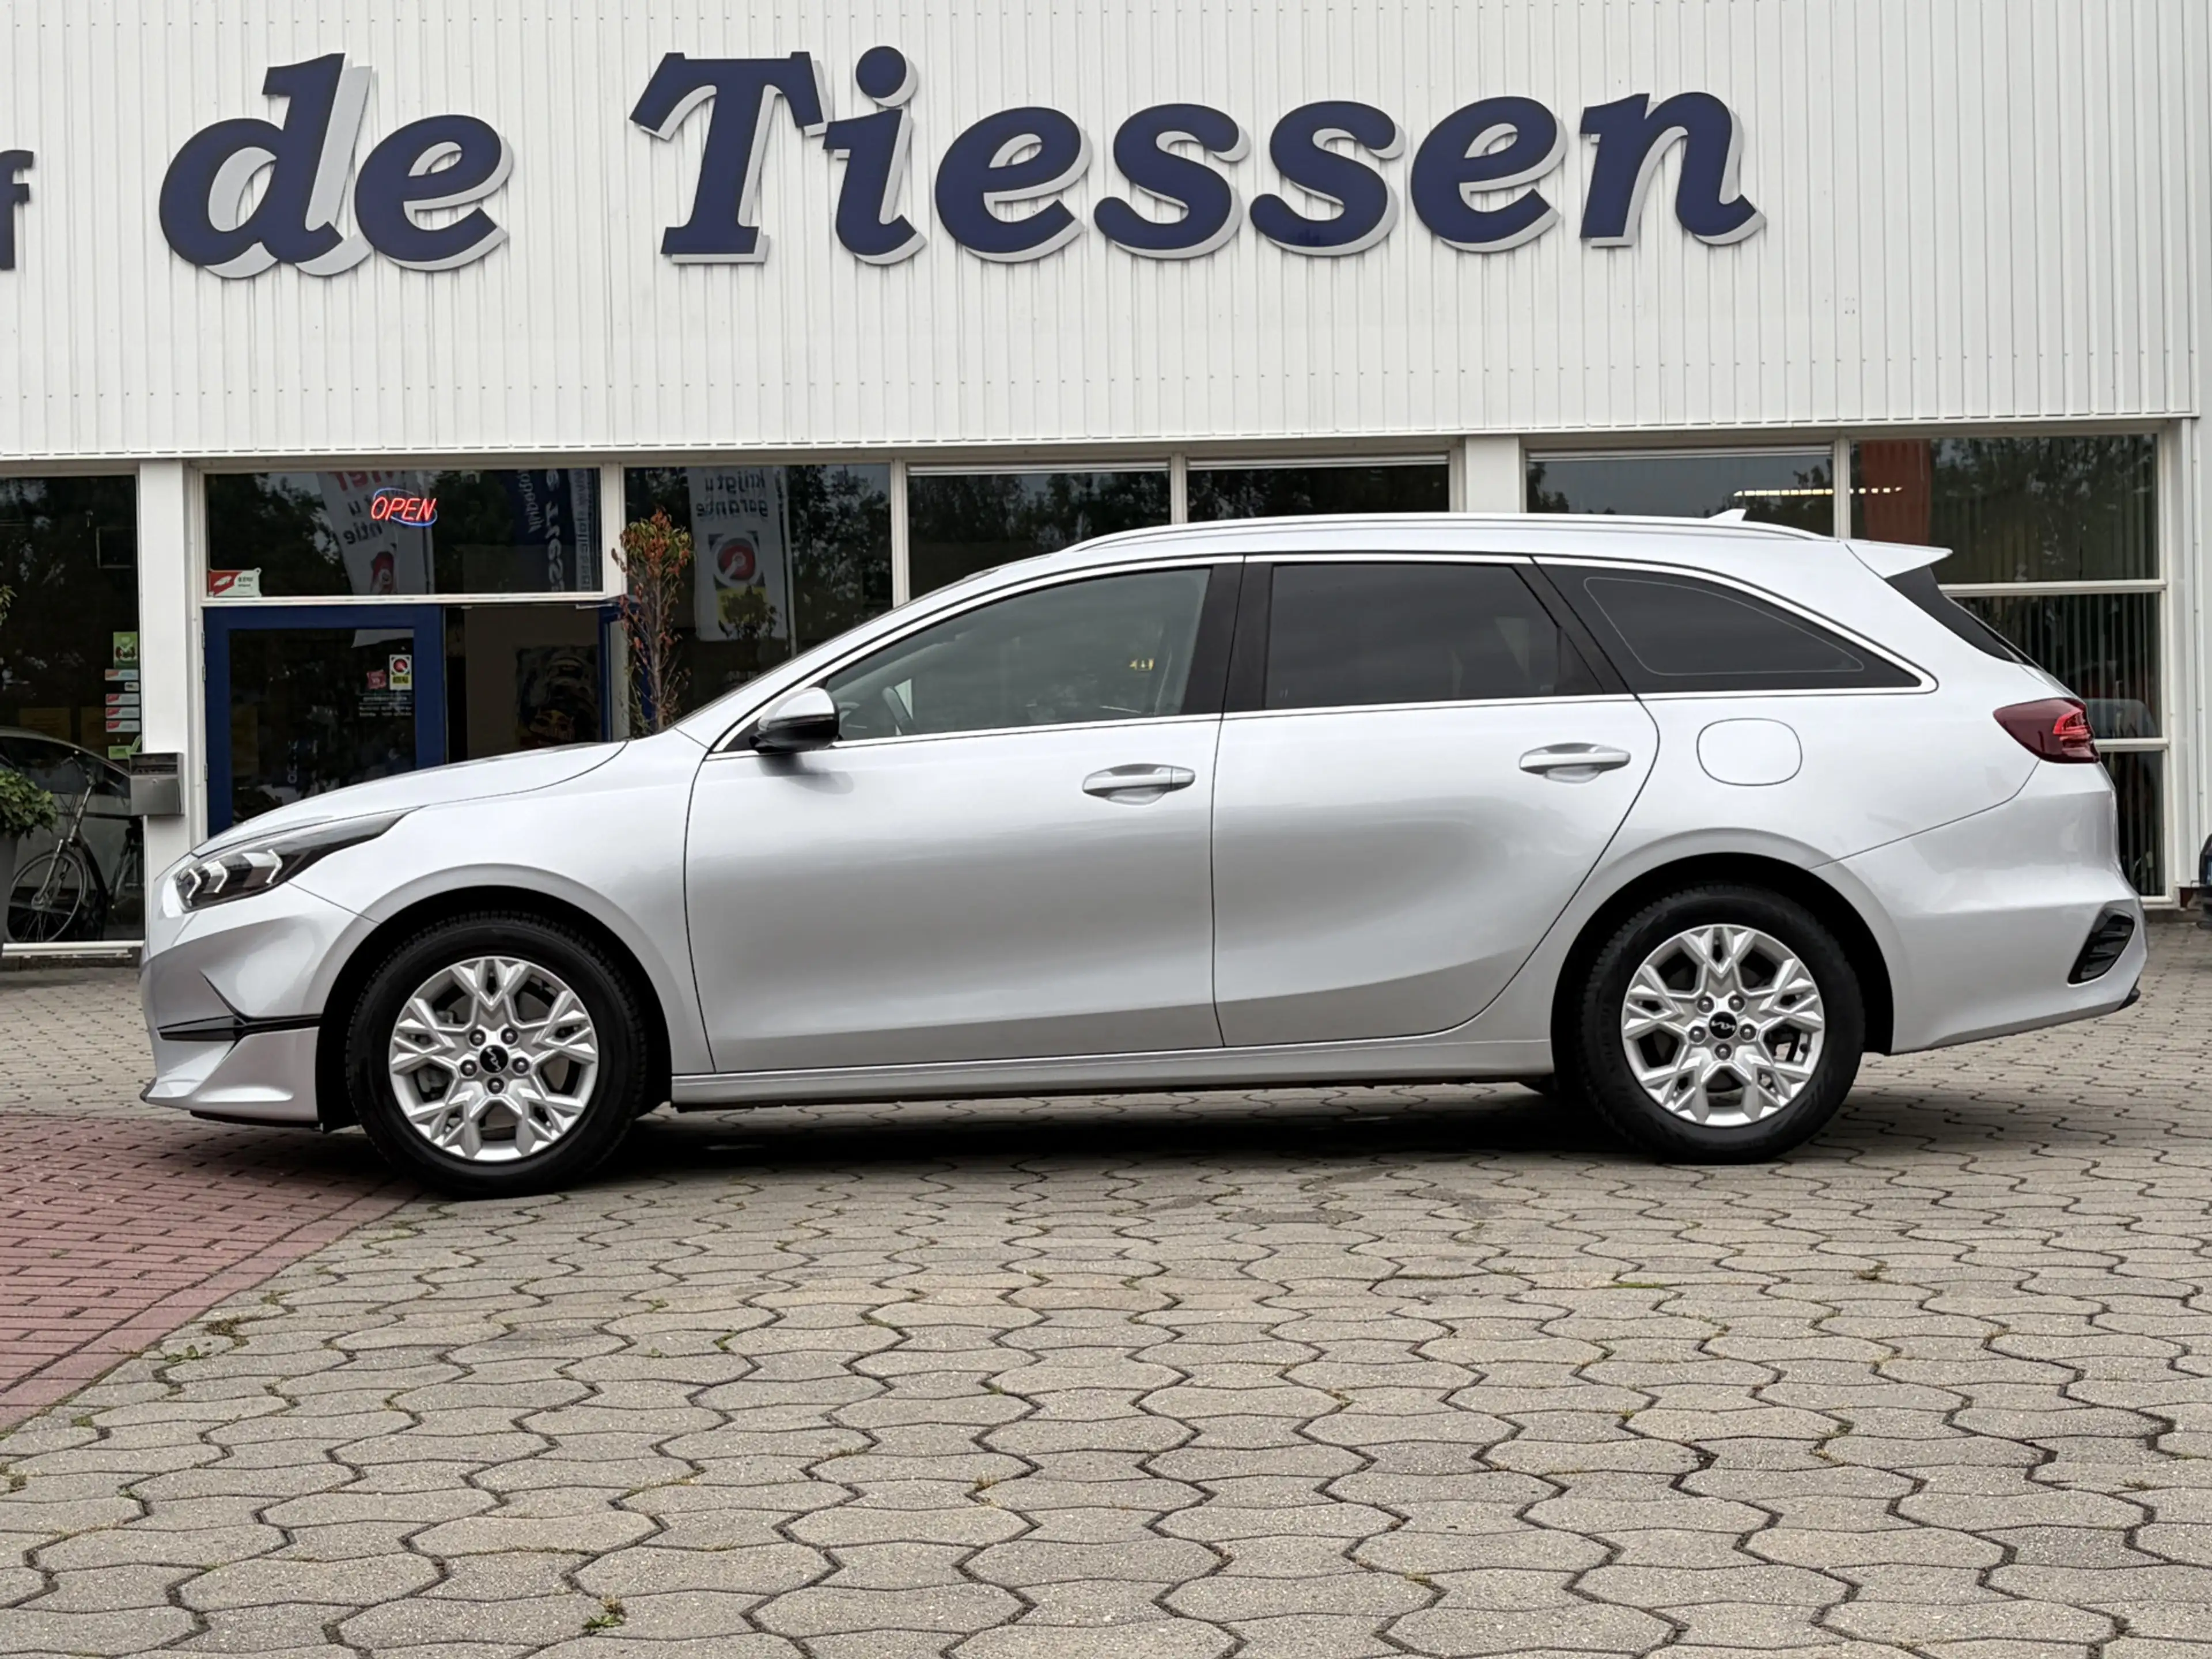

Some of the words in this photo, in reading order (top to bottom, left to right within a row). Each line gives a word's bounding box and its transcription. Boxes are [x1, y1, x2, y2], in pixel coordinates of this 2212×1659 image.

[160, 53, 508, 273] de
[630, 46, 1760, 260] Tiessen
[371, 496, 437, 521] OPEN
